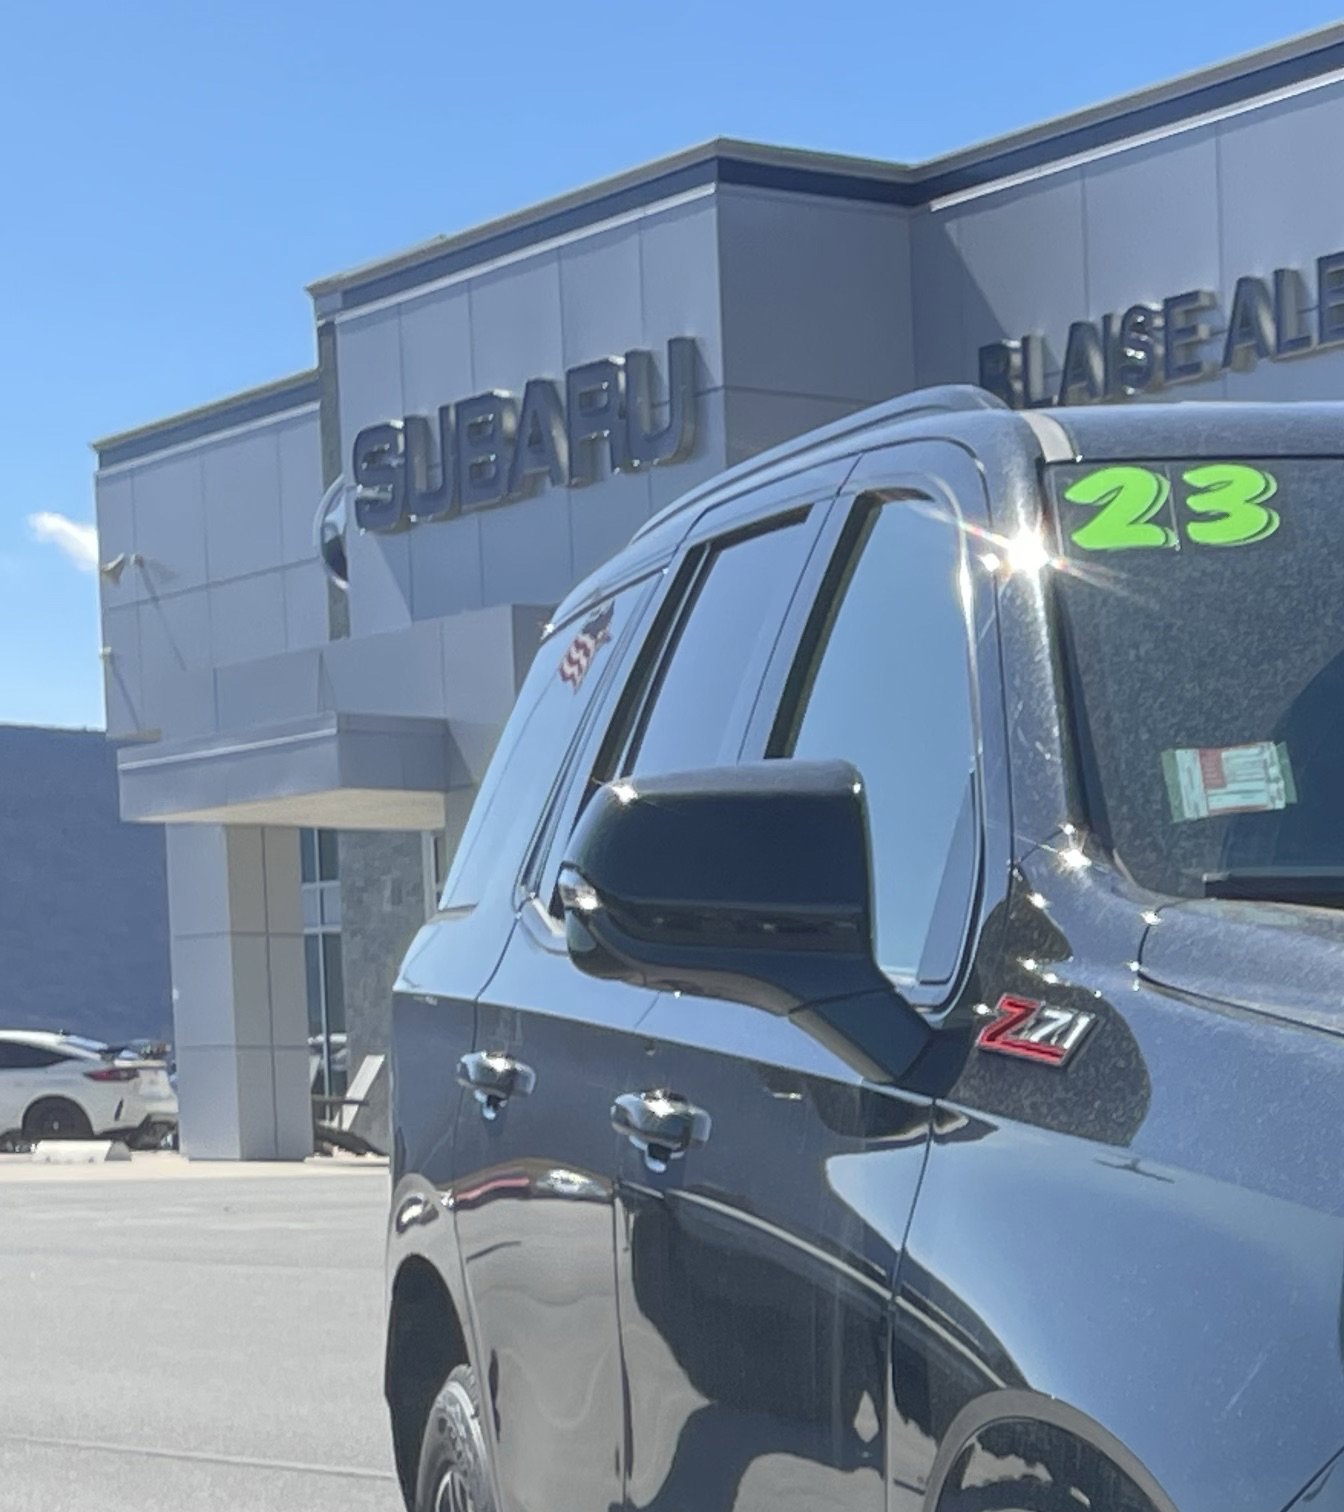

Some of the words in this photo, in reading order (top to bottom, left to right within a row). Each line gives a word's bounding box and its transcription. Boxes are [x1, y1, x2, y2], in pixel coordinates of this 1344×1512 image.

[353, 335, 698, 533] SUBARU
[1064, 463, 1281, 551] 23
[974, 992, 1096, 1067] Z71
